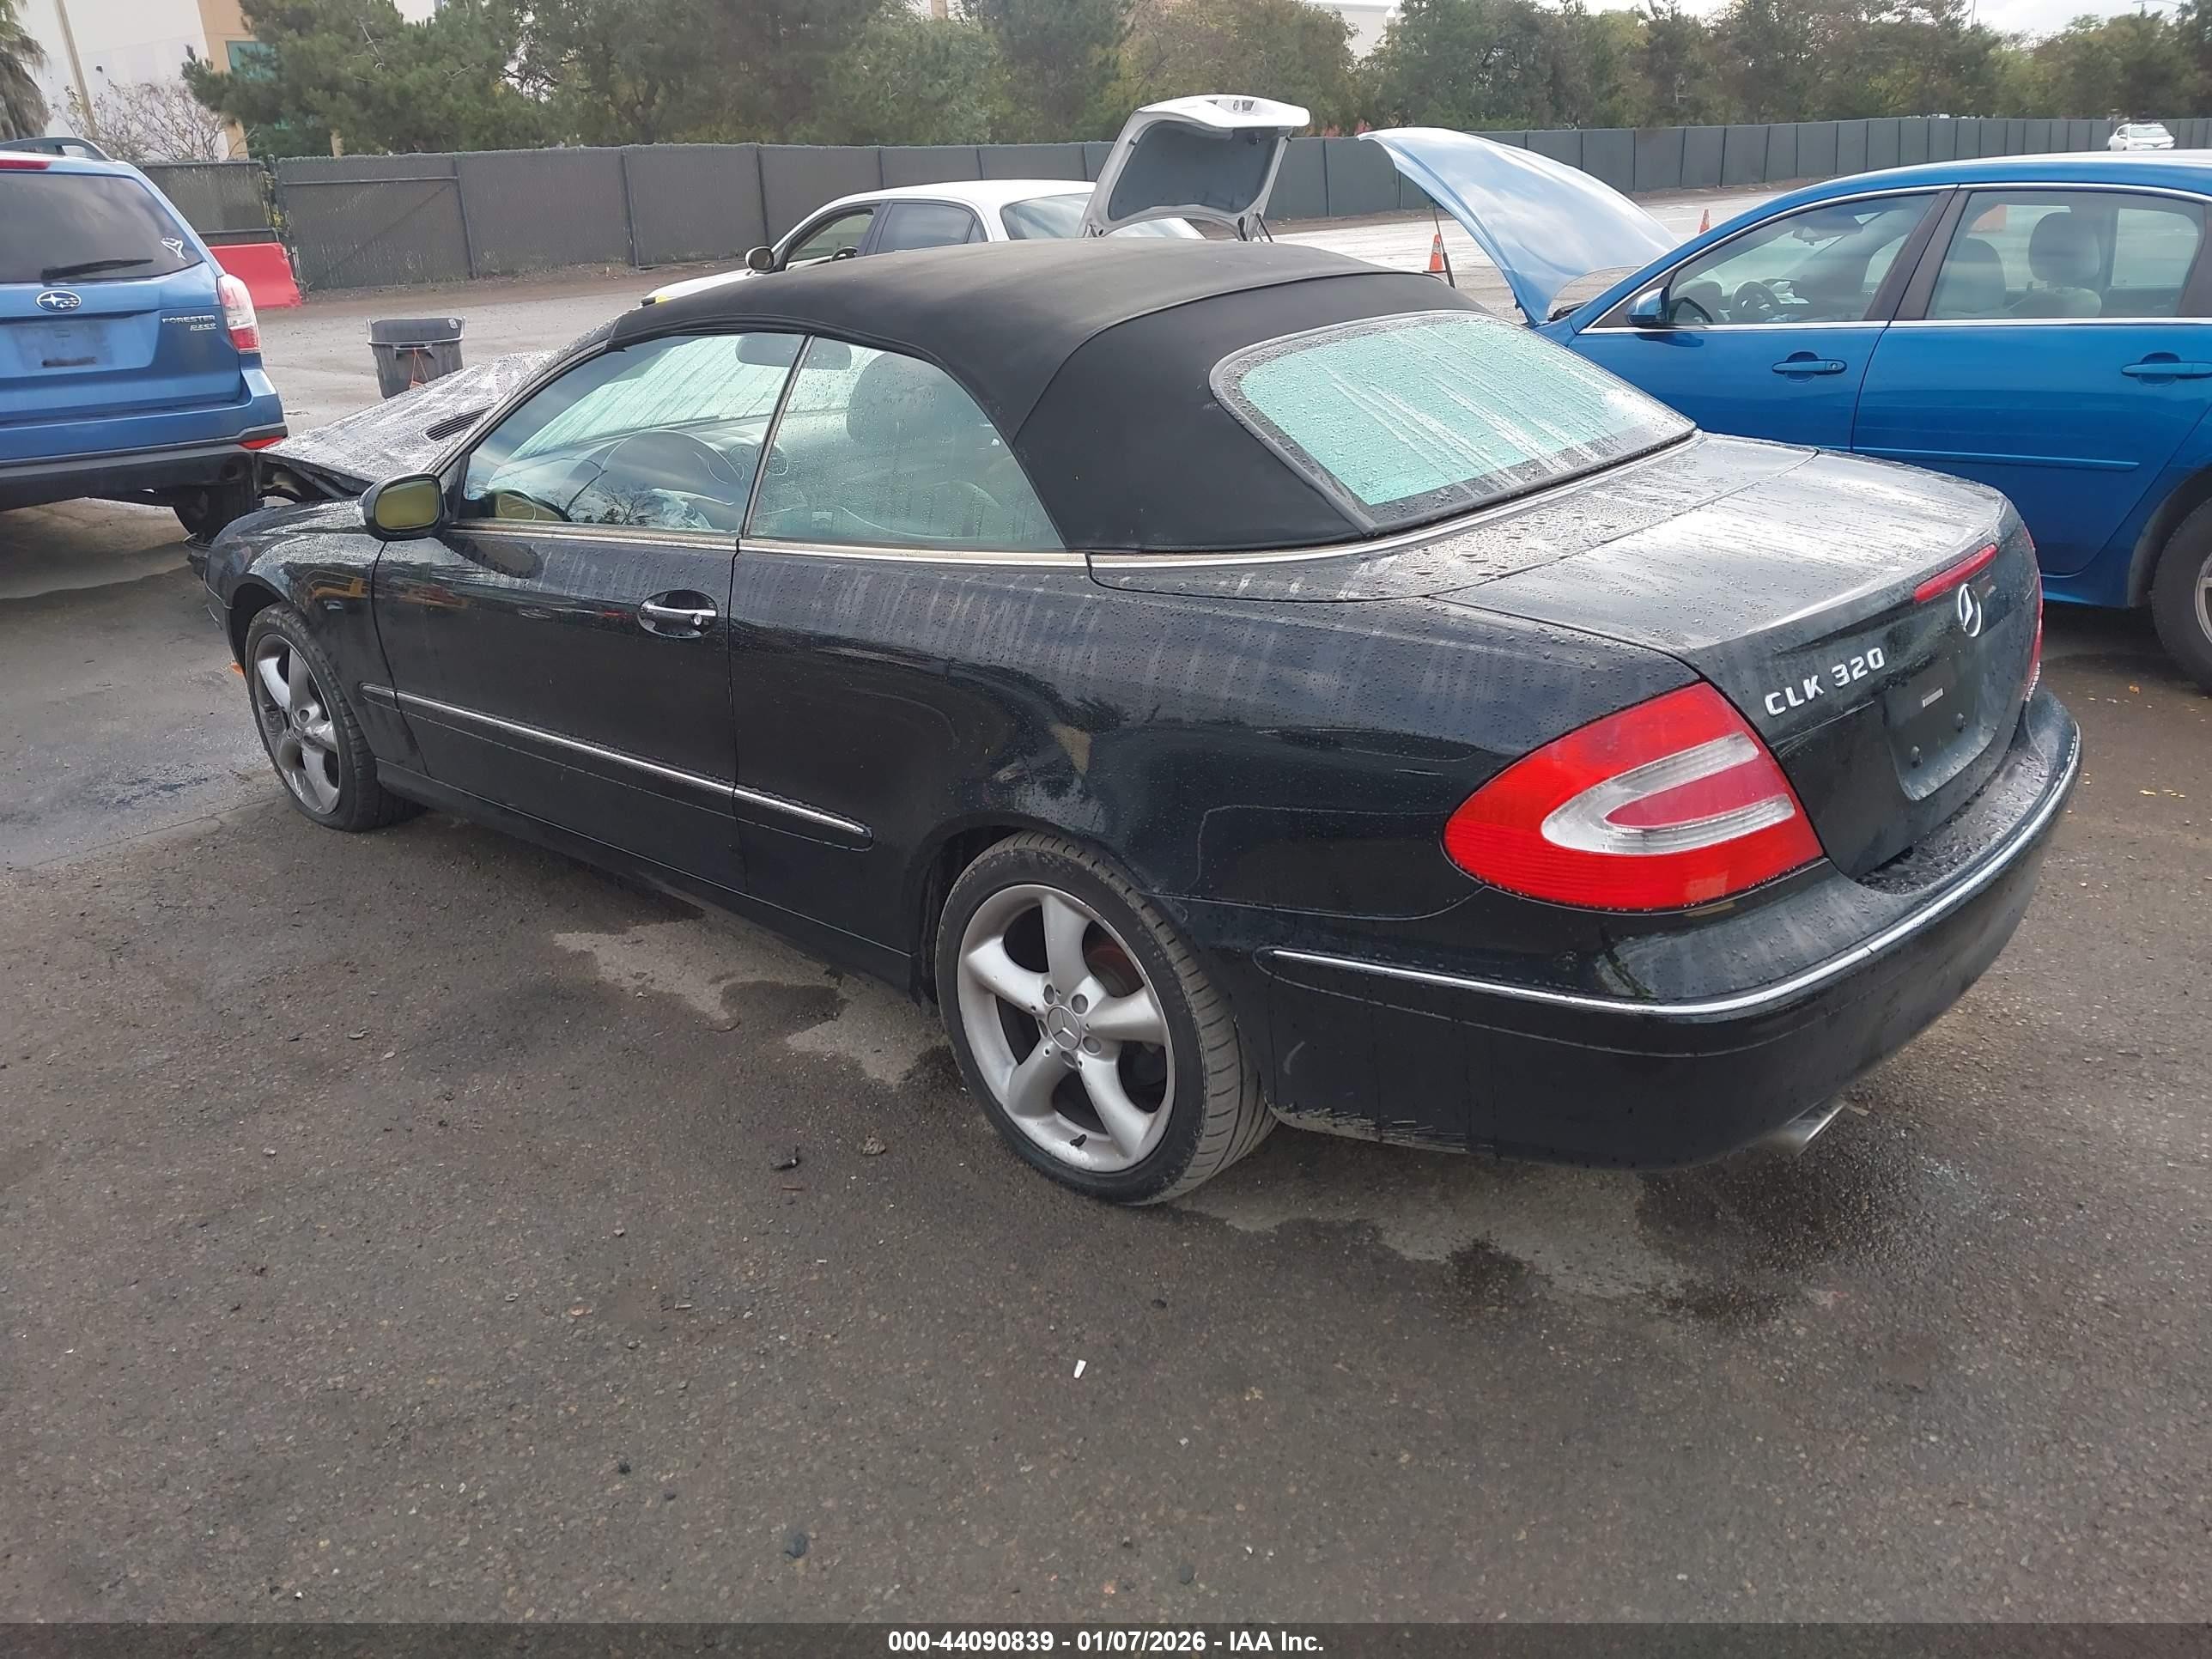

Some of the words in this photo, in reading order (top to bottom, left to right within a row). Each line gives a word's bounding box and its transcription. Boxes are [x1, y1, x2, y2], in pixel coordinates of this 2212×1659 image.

[161, 314, 216, 324] FORESTER
[1765, 675, 1825, 717] CLK
[1831, 647, 1885, 688] 320
